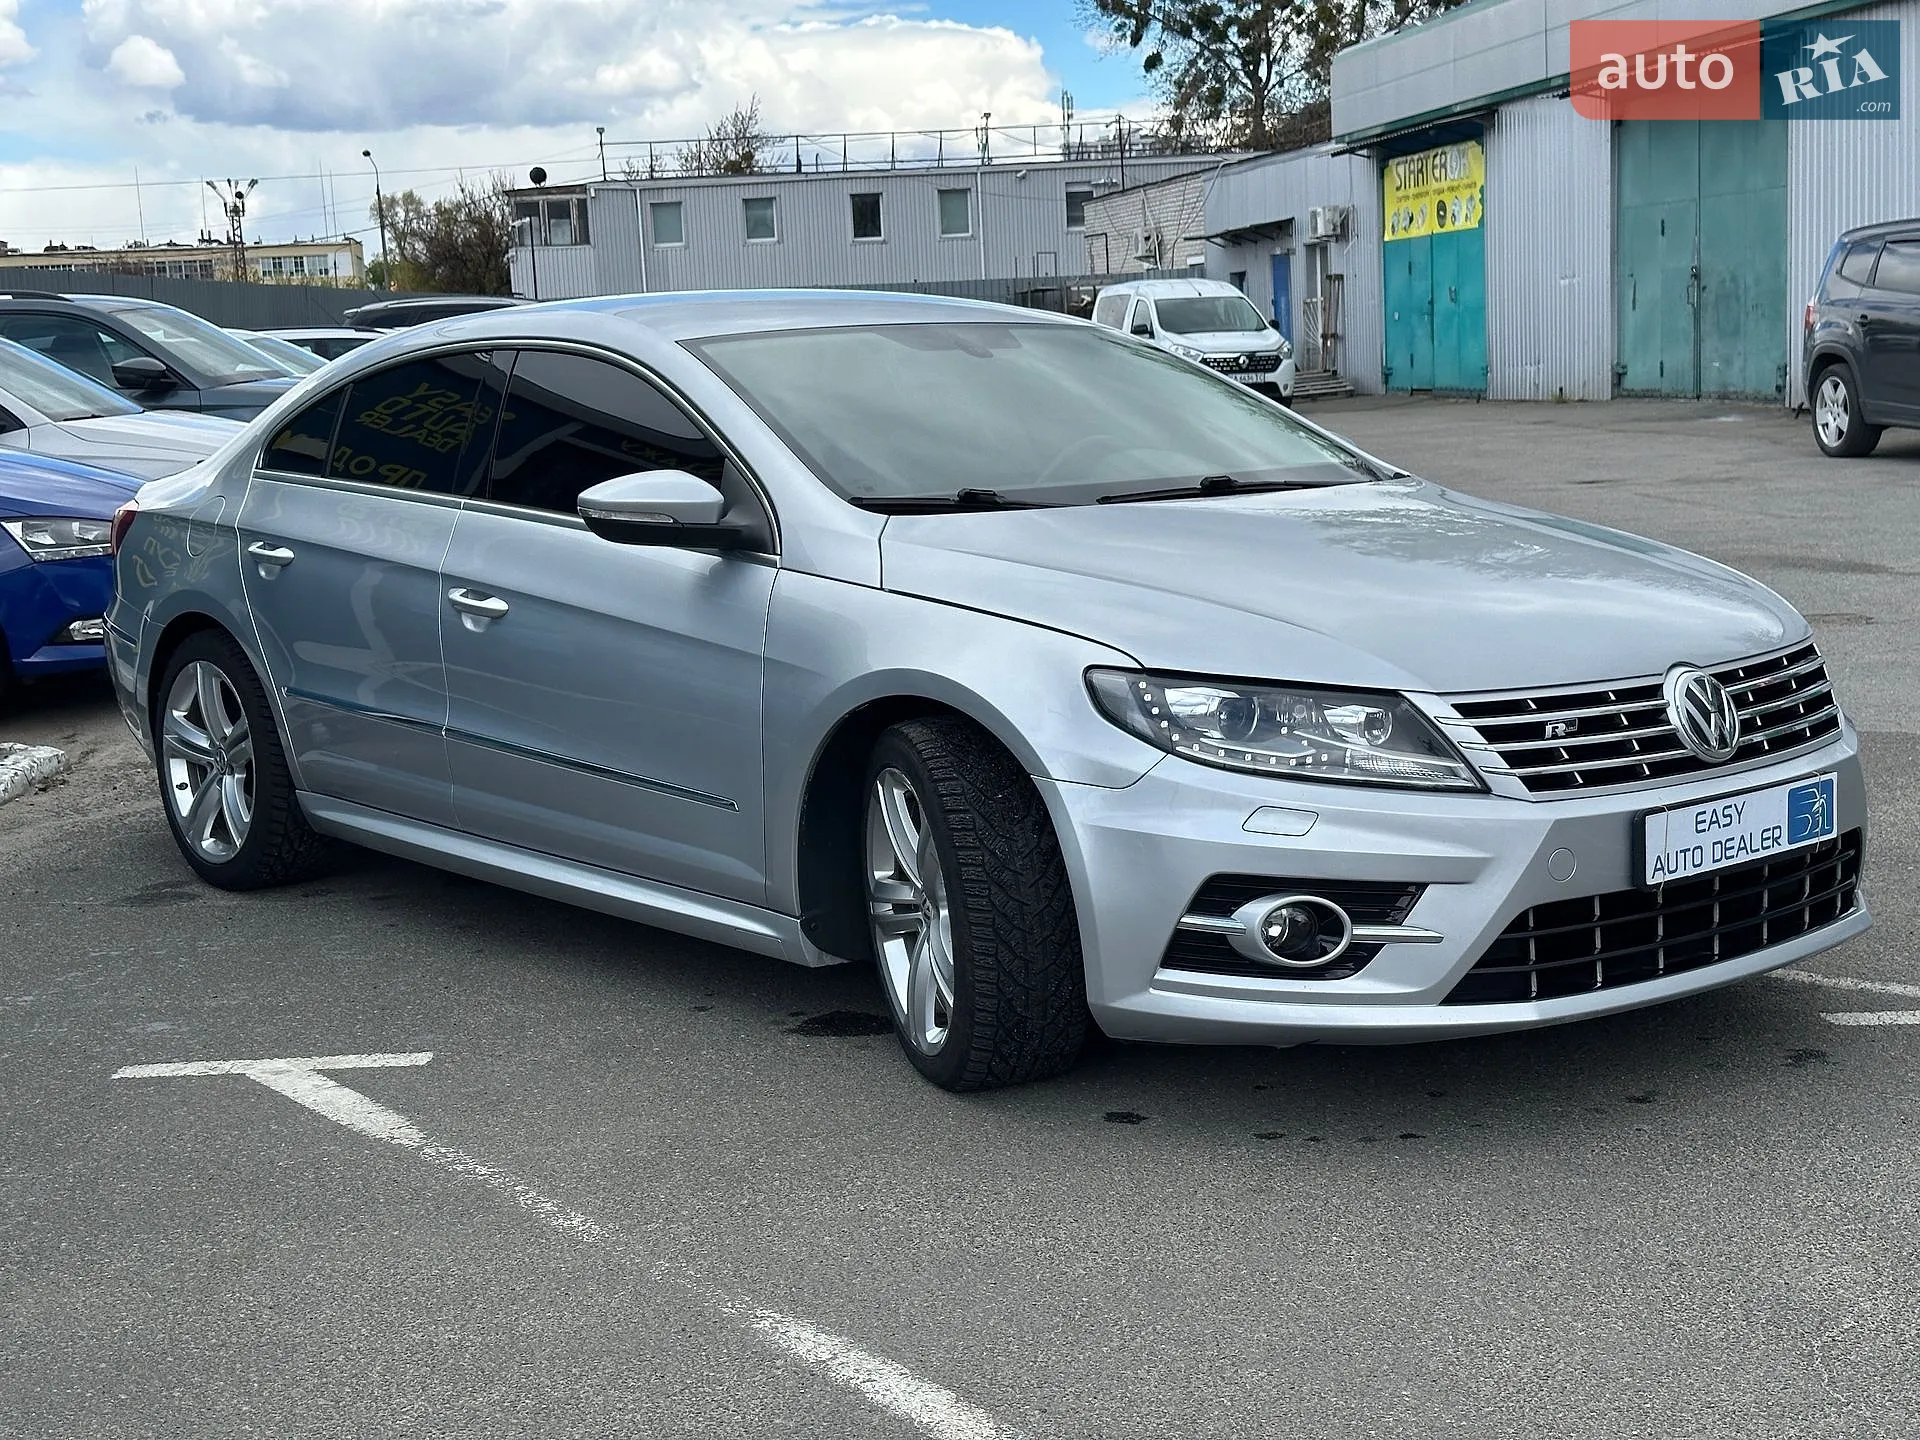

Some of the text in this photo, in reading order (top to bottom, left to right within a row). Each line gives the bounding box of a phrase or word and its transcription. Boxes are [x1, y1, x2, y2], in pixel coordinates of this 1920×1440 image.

[1695, 801, 1746, 834] EASY
[1651, 825, 1782, 880] AUTO DEALER
